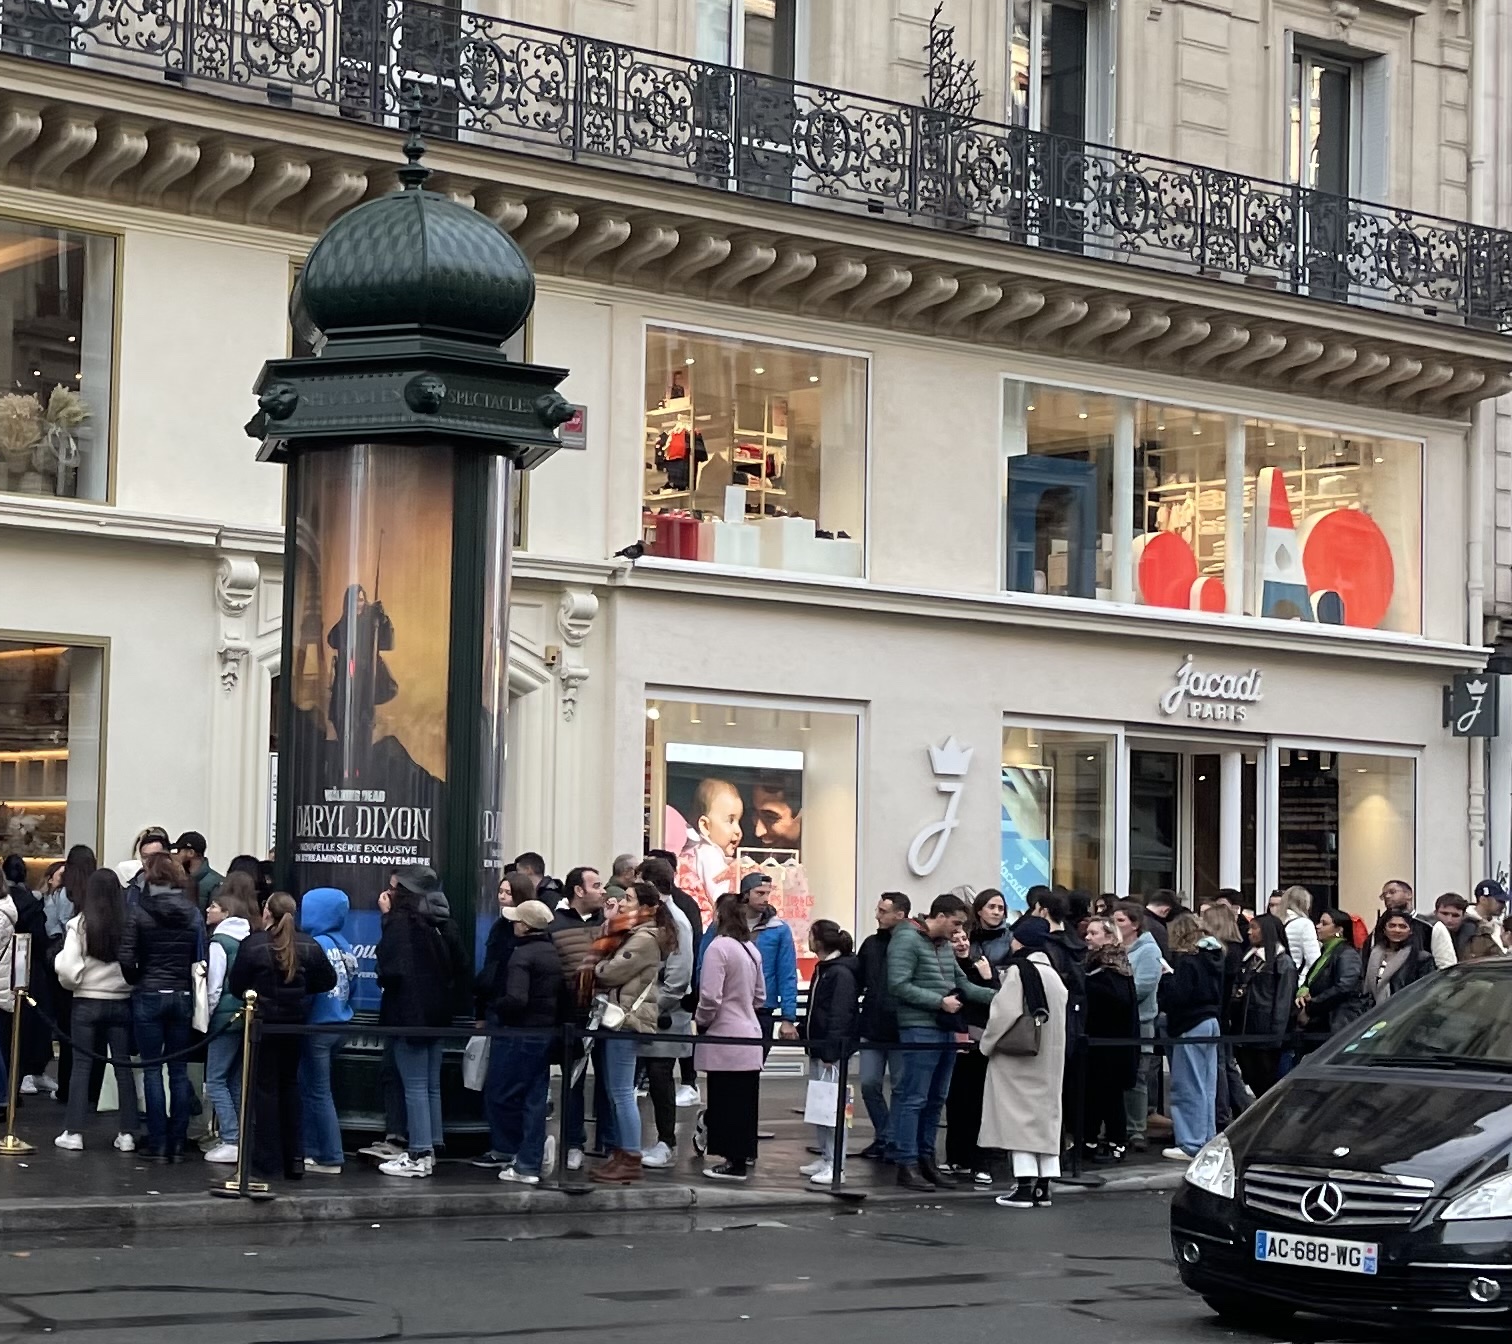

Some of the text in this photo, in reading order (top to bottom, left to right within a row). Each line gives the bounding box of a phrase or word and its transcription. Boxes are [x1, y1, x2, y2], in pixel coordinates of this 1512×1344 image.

[448, 391, 535, 413] SPECTACLES
[1160, 653, 1264, 715] jacadi
[1187, 702, 1248, 721] PARIS
[296, 805, 350, 838] DARYL
[355, 806, 432, 842] DIXON
[336, 841, 362, 853] SÉRIE
[364, 844, 418, 855] EXCLUSIVE
[345, 854, 357, 864] LE
[358, 855, 370, 864] 10
[373, 856, 431, 866] NOVEMBRE
[1267, 1237, 1361, 1267] AC-688-WG
